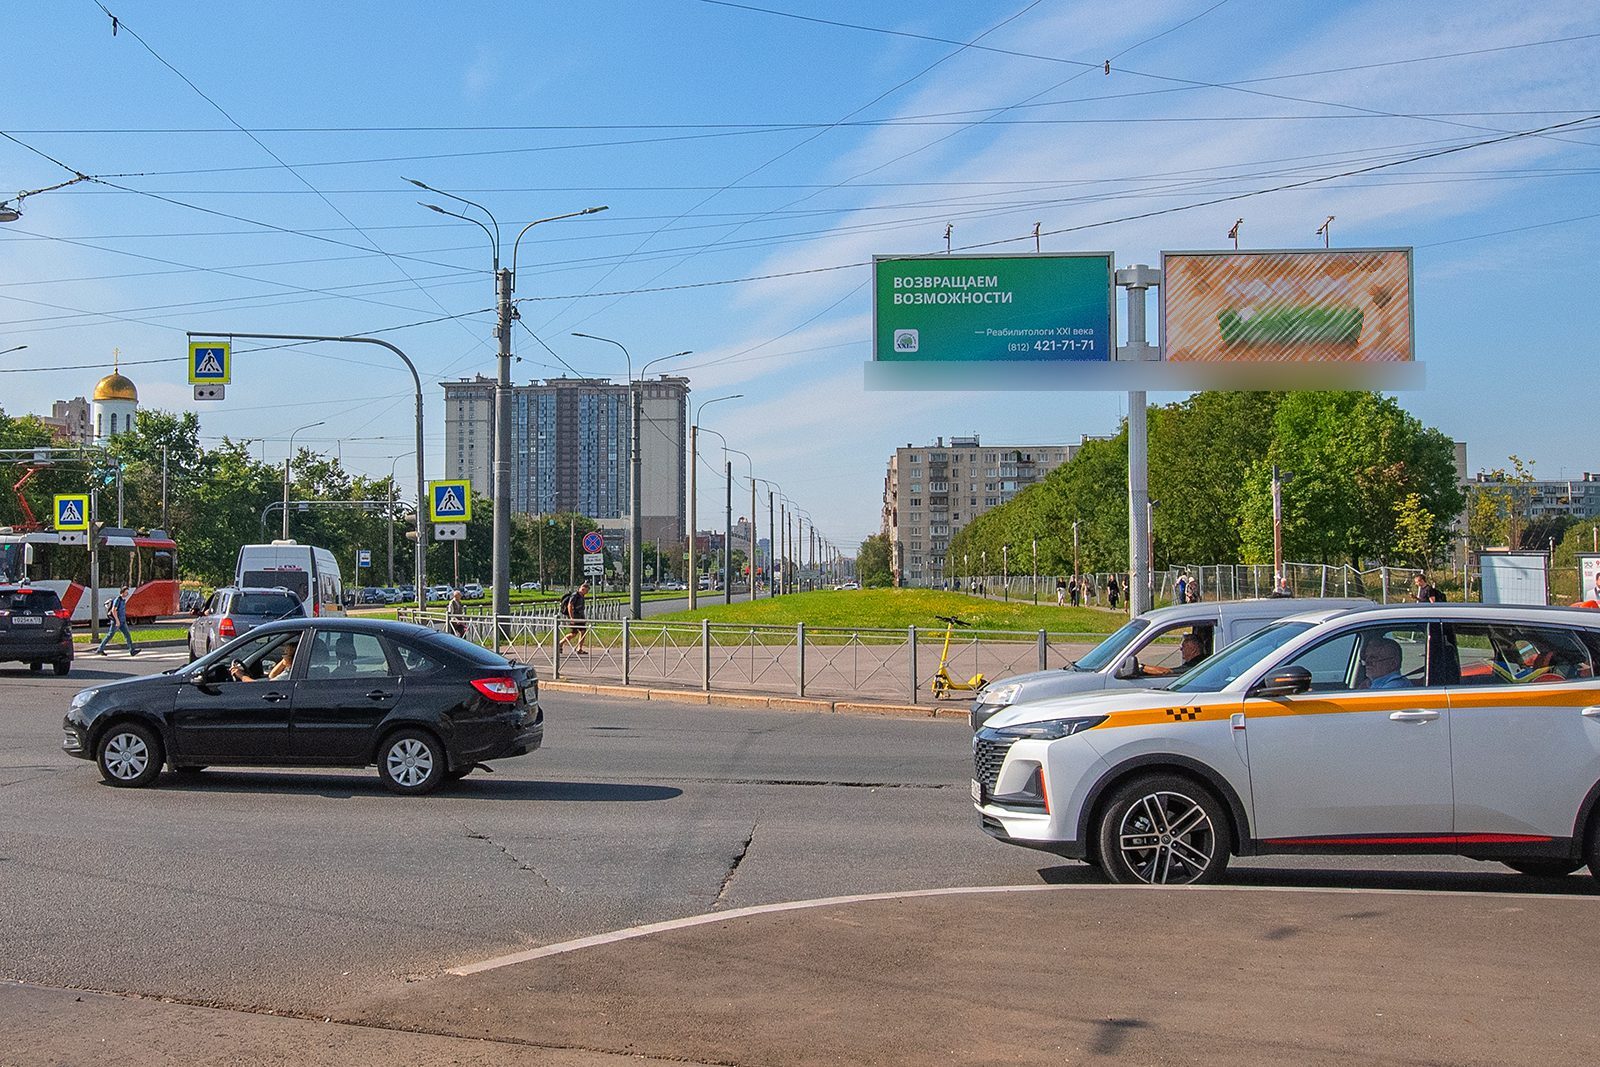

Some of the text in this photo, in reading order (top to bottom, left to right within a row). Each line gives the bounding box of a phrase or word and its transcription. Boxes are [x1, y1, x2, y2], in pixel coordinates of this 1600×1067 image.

[893, 276, 998, 290] ВОЗВРАЩАЕМ
[893, 291, 1013, 305] ВОЗМОЖНОСТИ
[986, 328, 1055, 337] Реабилитологи
[1056, 327, 1071, 336] XXI
[1073, 328, 1094, 336] века
[1007, 339, 1094, 352] (812) 421-71-71
